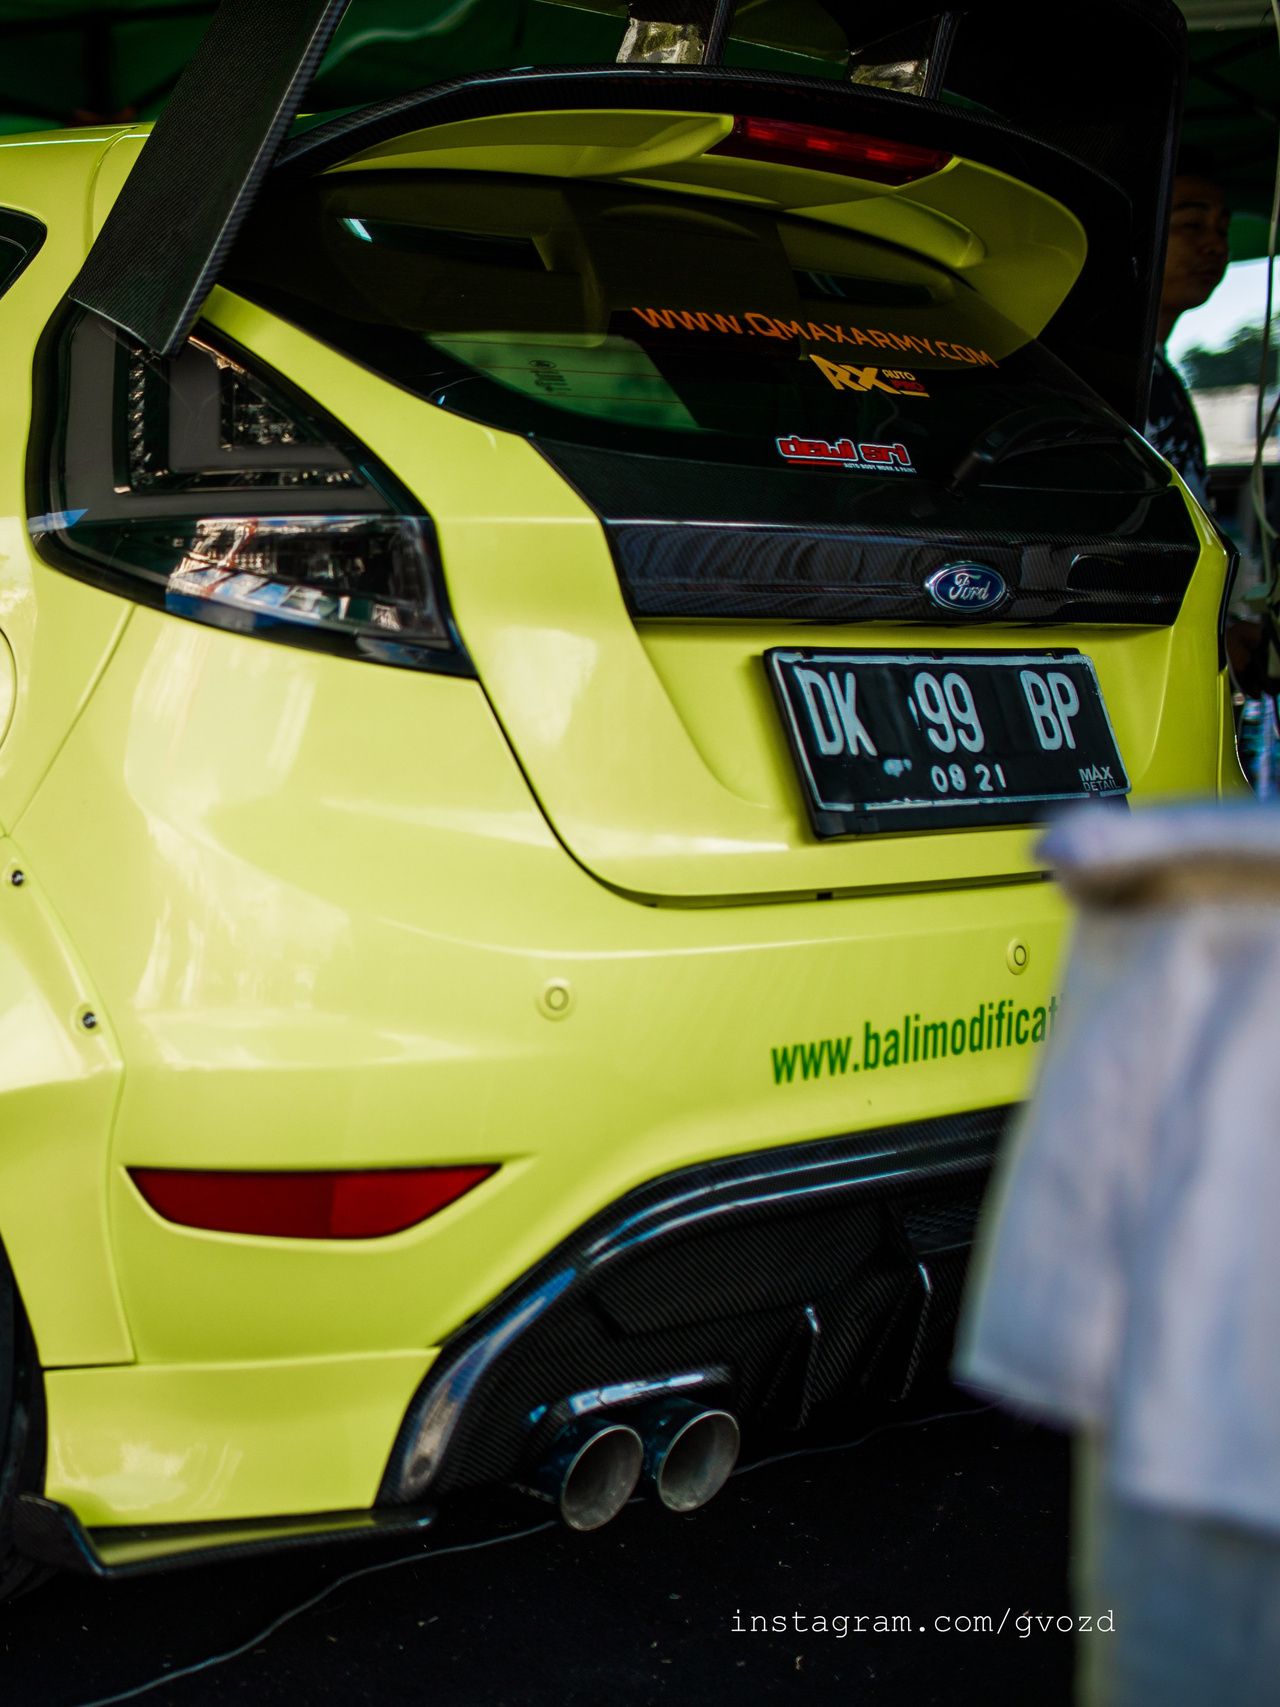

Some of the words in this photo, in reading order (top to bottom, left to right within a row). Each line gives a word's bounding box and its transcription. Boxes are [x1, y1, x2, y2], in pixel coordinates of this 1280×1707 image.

[631, 306, 1000, 369] WWW.QMAXARMY.COM
[881, 368, 916, 381] AUTO
[890, 379, 926, 392] PRO
[948, 572, 991, 601] Ford
[793, 666, 878, 756] DK
[913, 671, 985, 753] 99
[1020, 670, 1080, 750] BP
[1078, 763, 1114, 782] MAX
[1082, 779, 1121, 792] DETAIL
[771, 993, 1064, 1086] www.balimodificat
